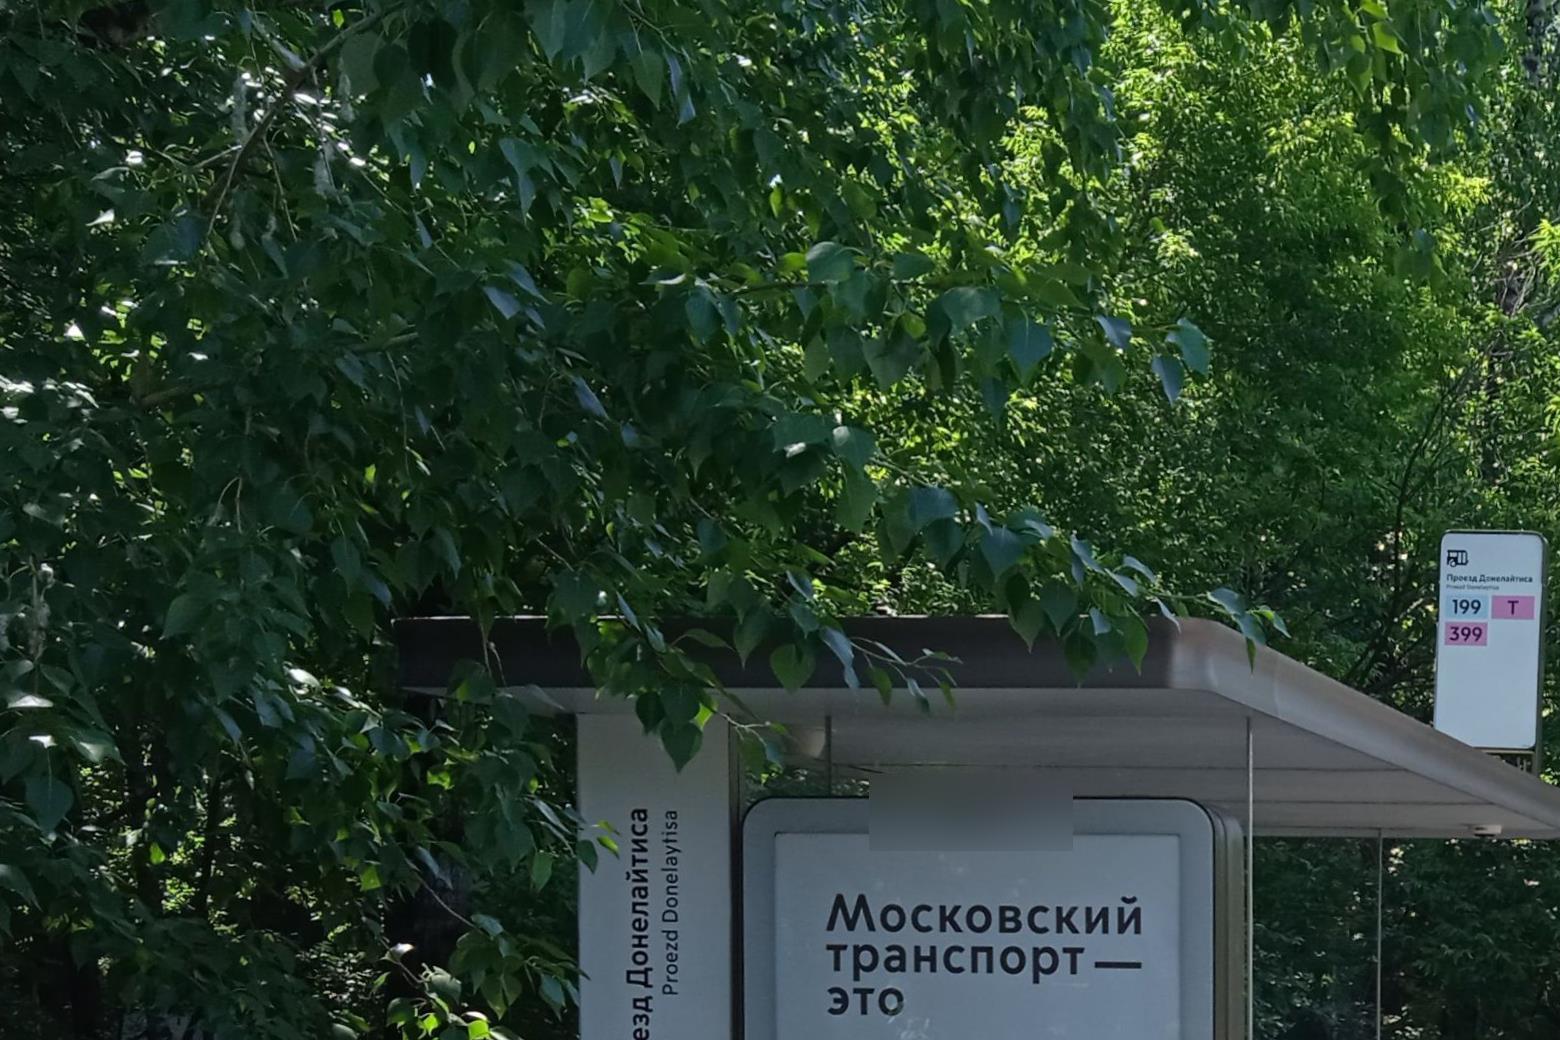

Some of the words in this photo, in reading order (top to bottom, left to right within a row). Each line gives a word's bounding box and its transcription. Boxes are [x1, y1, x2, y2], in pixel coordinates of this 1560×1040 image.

[1446, 573, 1477, 583] Проезд
[1452, 599, 1481, 615] 199
[1449, 626, 1482, 642] 399
[661, 810, 683, 923] Donelaytisa
[626, 808, 654, 988] Донелайтиса
[825, 893, 1142, 935] Московский
[662, 930, 679, 995] Proezd
[825, 943, 1085, 985] транспорт
[826, 986, 905, 1017] это
